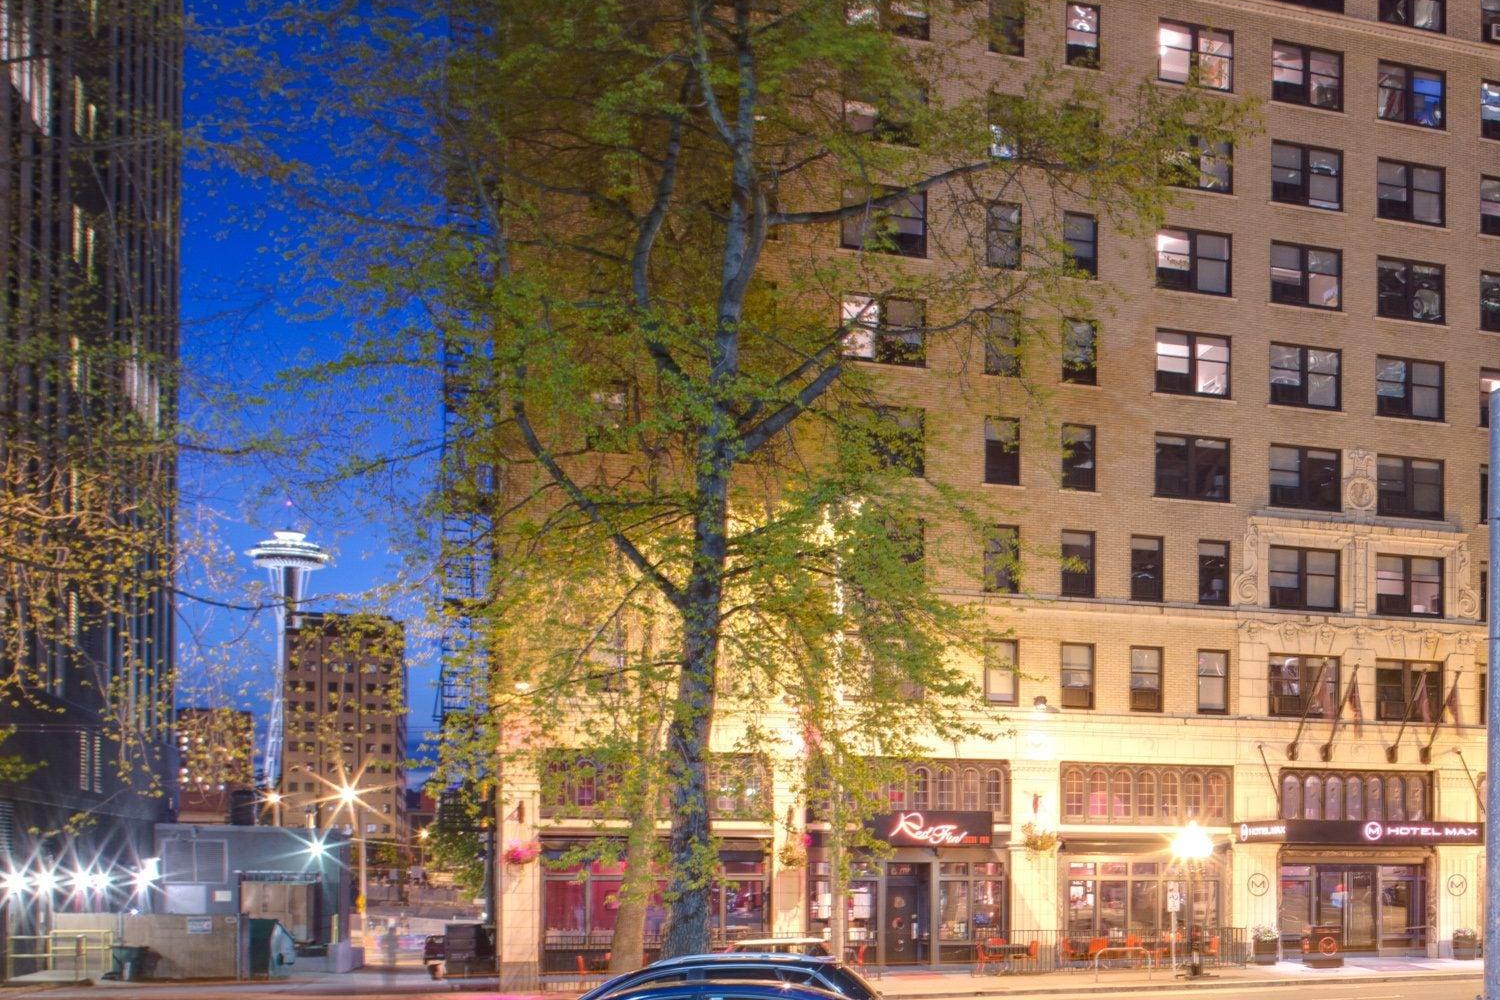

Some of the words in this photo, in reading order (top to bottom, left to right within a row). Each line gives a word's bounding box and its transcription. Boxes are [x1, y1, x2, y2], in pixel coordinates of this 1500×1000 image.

[889, 811, 934, 840] Red
[1386, 826, 1442, 836] HOTEL
[1444, 827, 1478, 836] MAX
